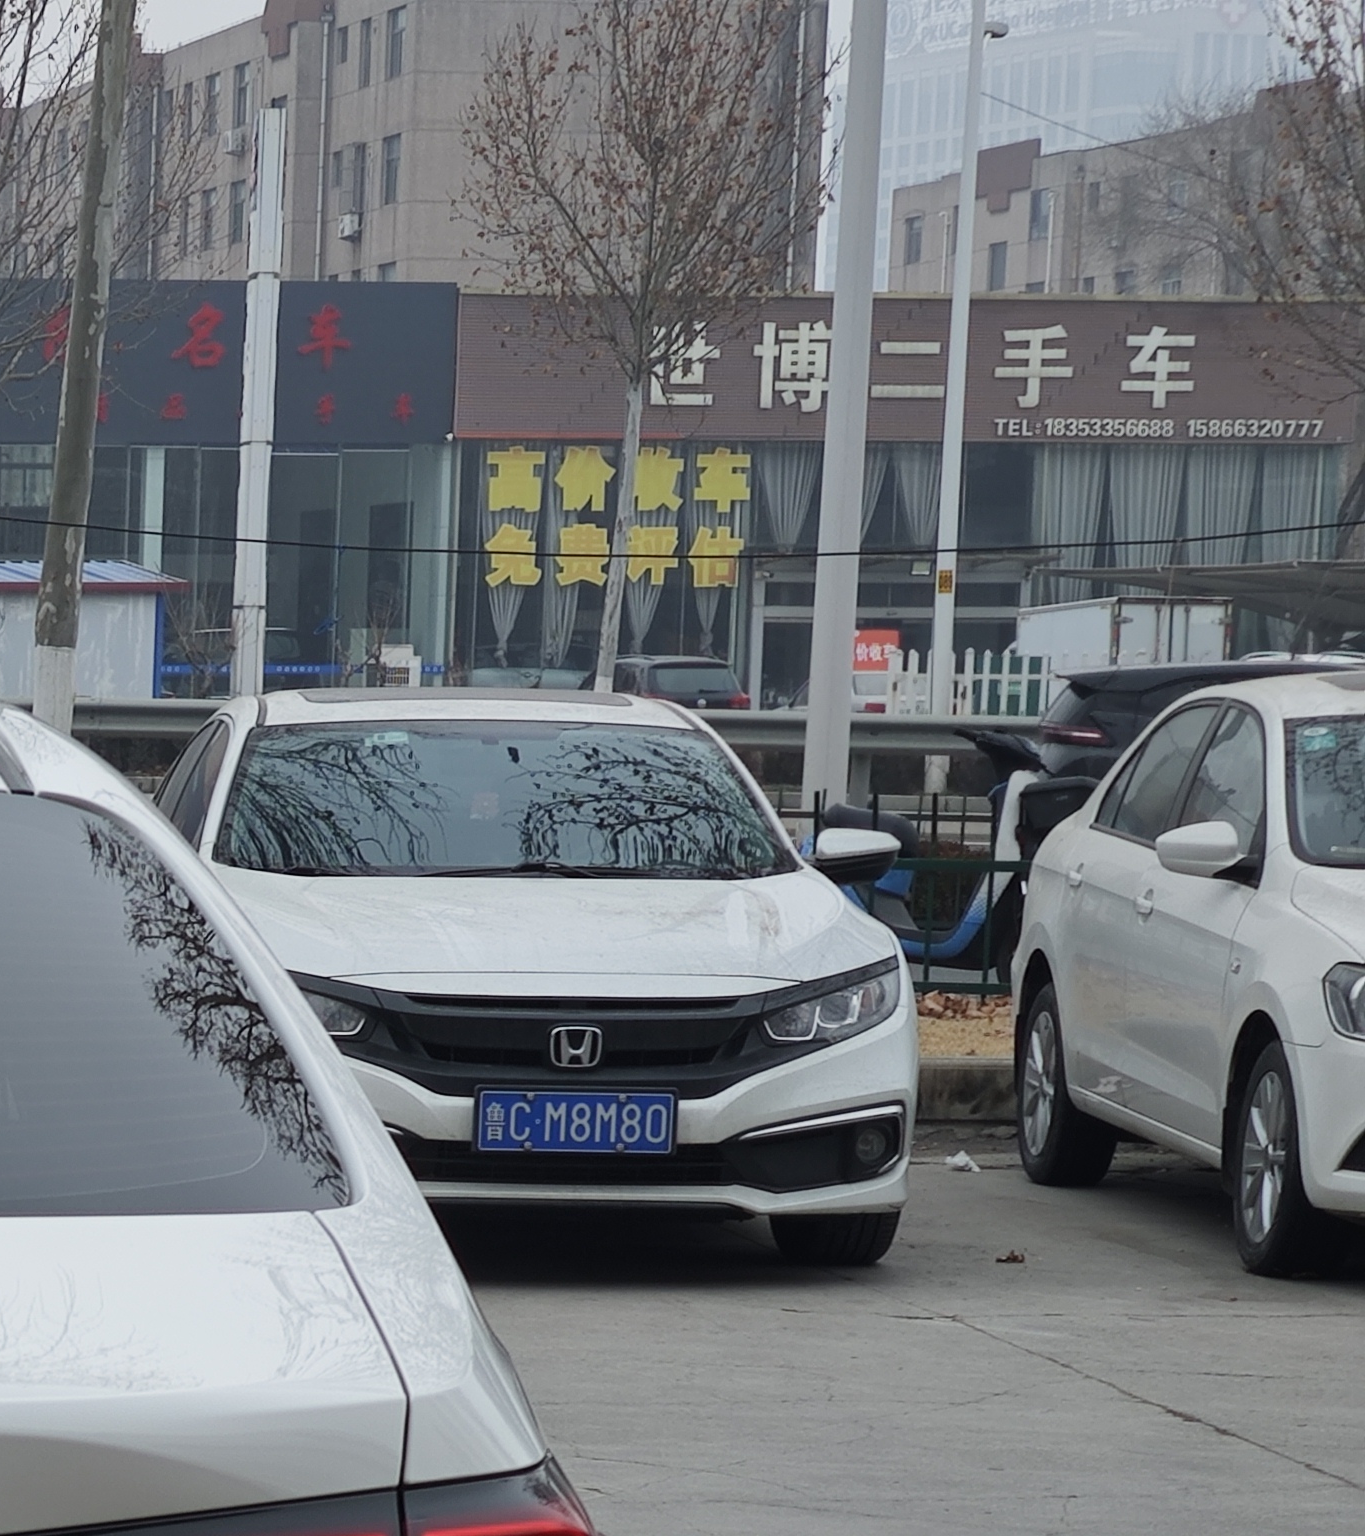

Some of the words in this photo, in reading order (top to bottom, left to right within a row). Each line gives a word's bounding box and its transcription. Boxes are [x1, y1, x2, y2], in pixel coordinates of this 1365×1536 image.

[650, 320, 1196, 412] 世博二手车
[1187, 419, 1324, 439] 15866320777
[487, 446, 751, 513] 高价收车
[484, 523, 744, 588] 免费评估
